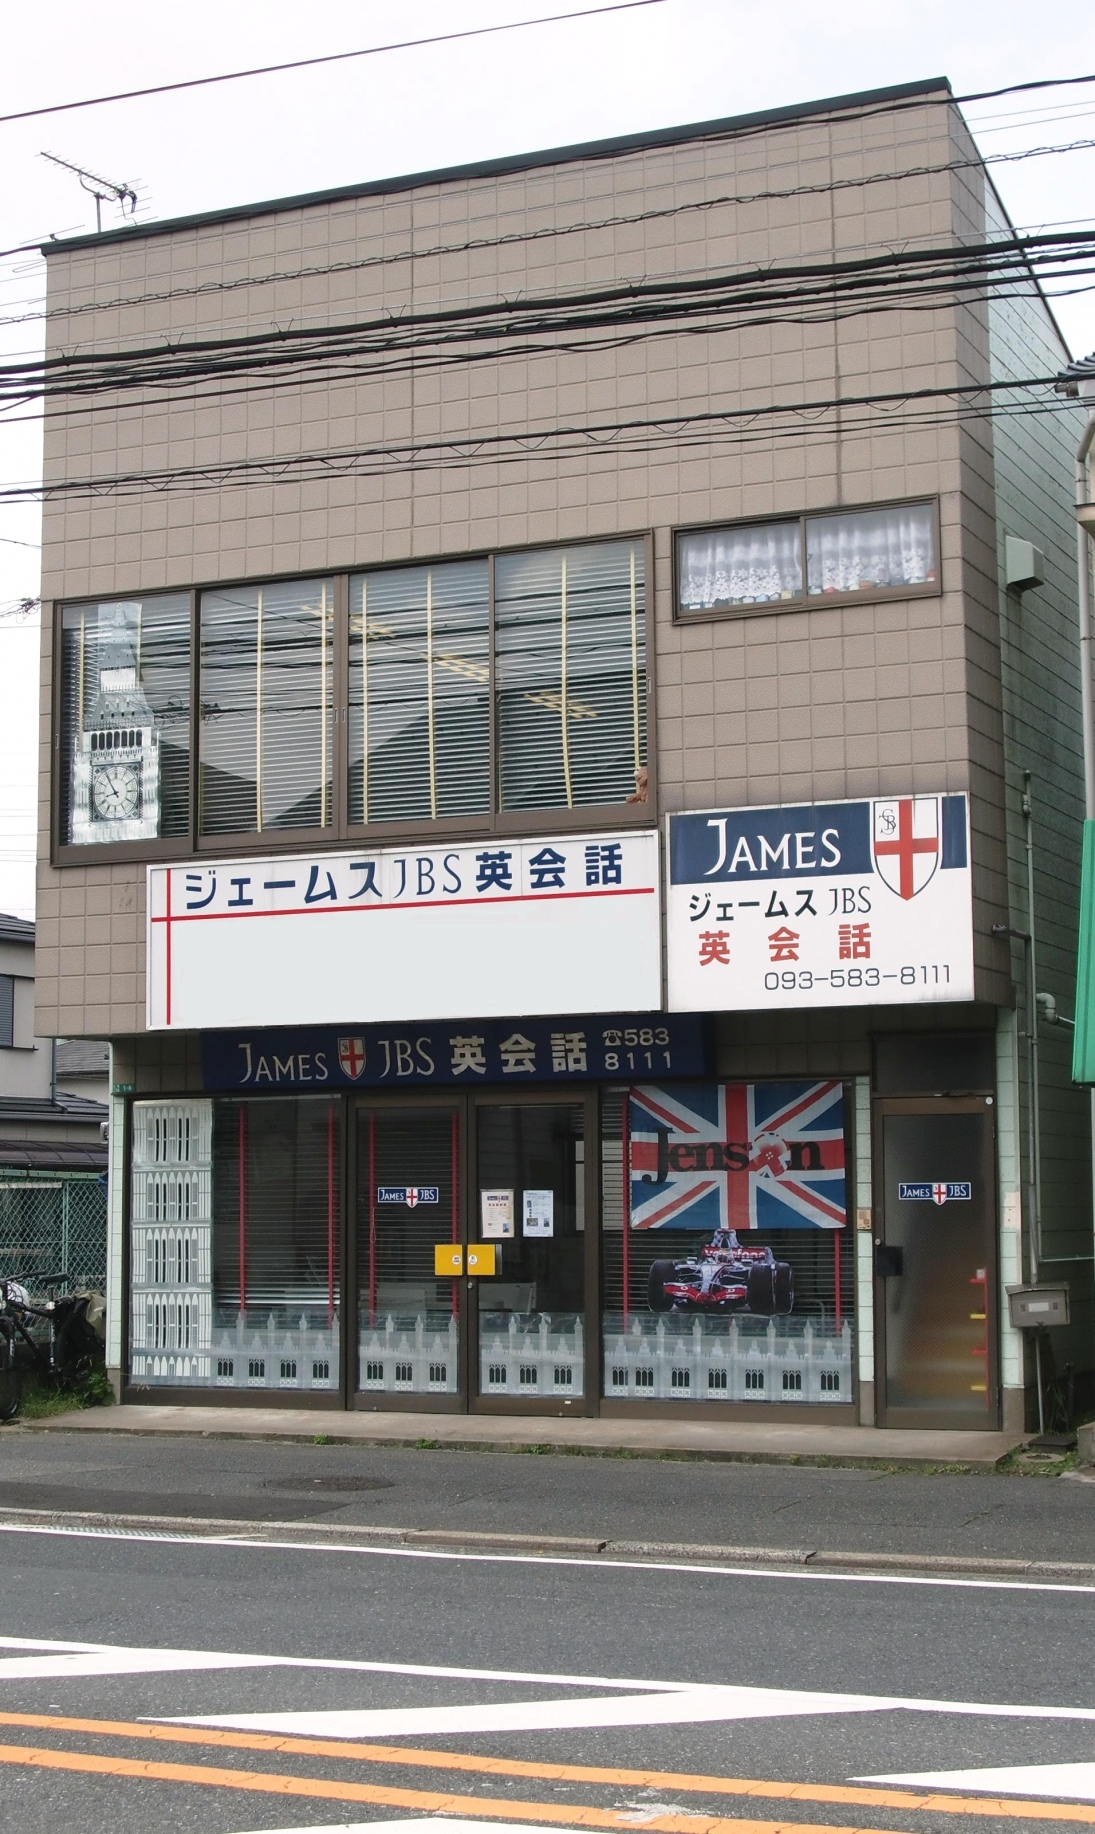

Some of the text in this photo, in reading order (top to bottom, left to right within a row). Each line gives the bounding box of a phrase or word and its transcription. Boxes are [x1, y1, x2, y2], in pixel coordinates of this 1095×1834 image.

[703, 818, 842, 876] JAMES
[764, 964, 951, 991] 093-583-8111
[238, 1031, 588, 1083] JAMES JBS 英会話
[604, 1051, 671, 1071] 8111
[380, 1189, 435, 1201] JAMES JBS
[901, 1185, 967, 1198] JAMES JBS
